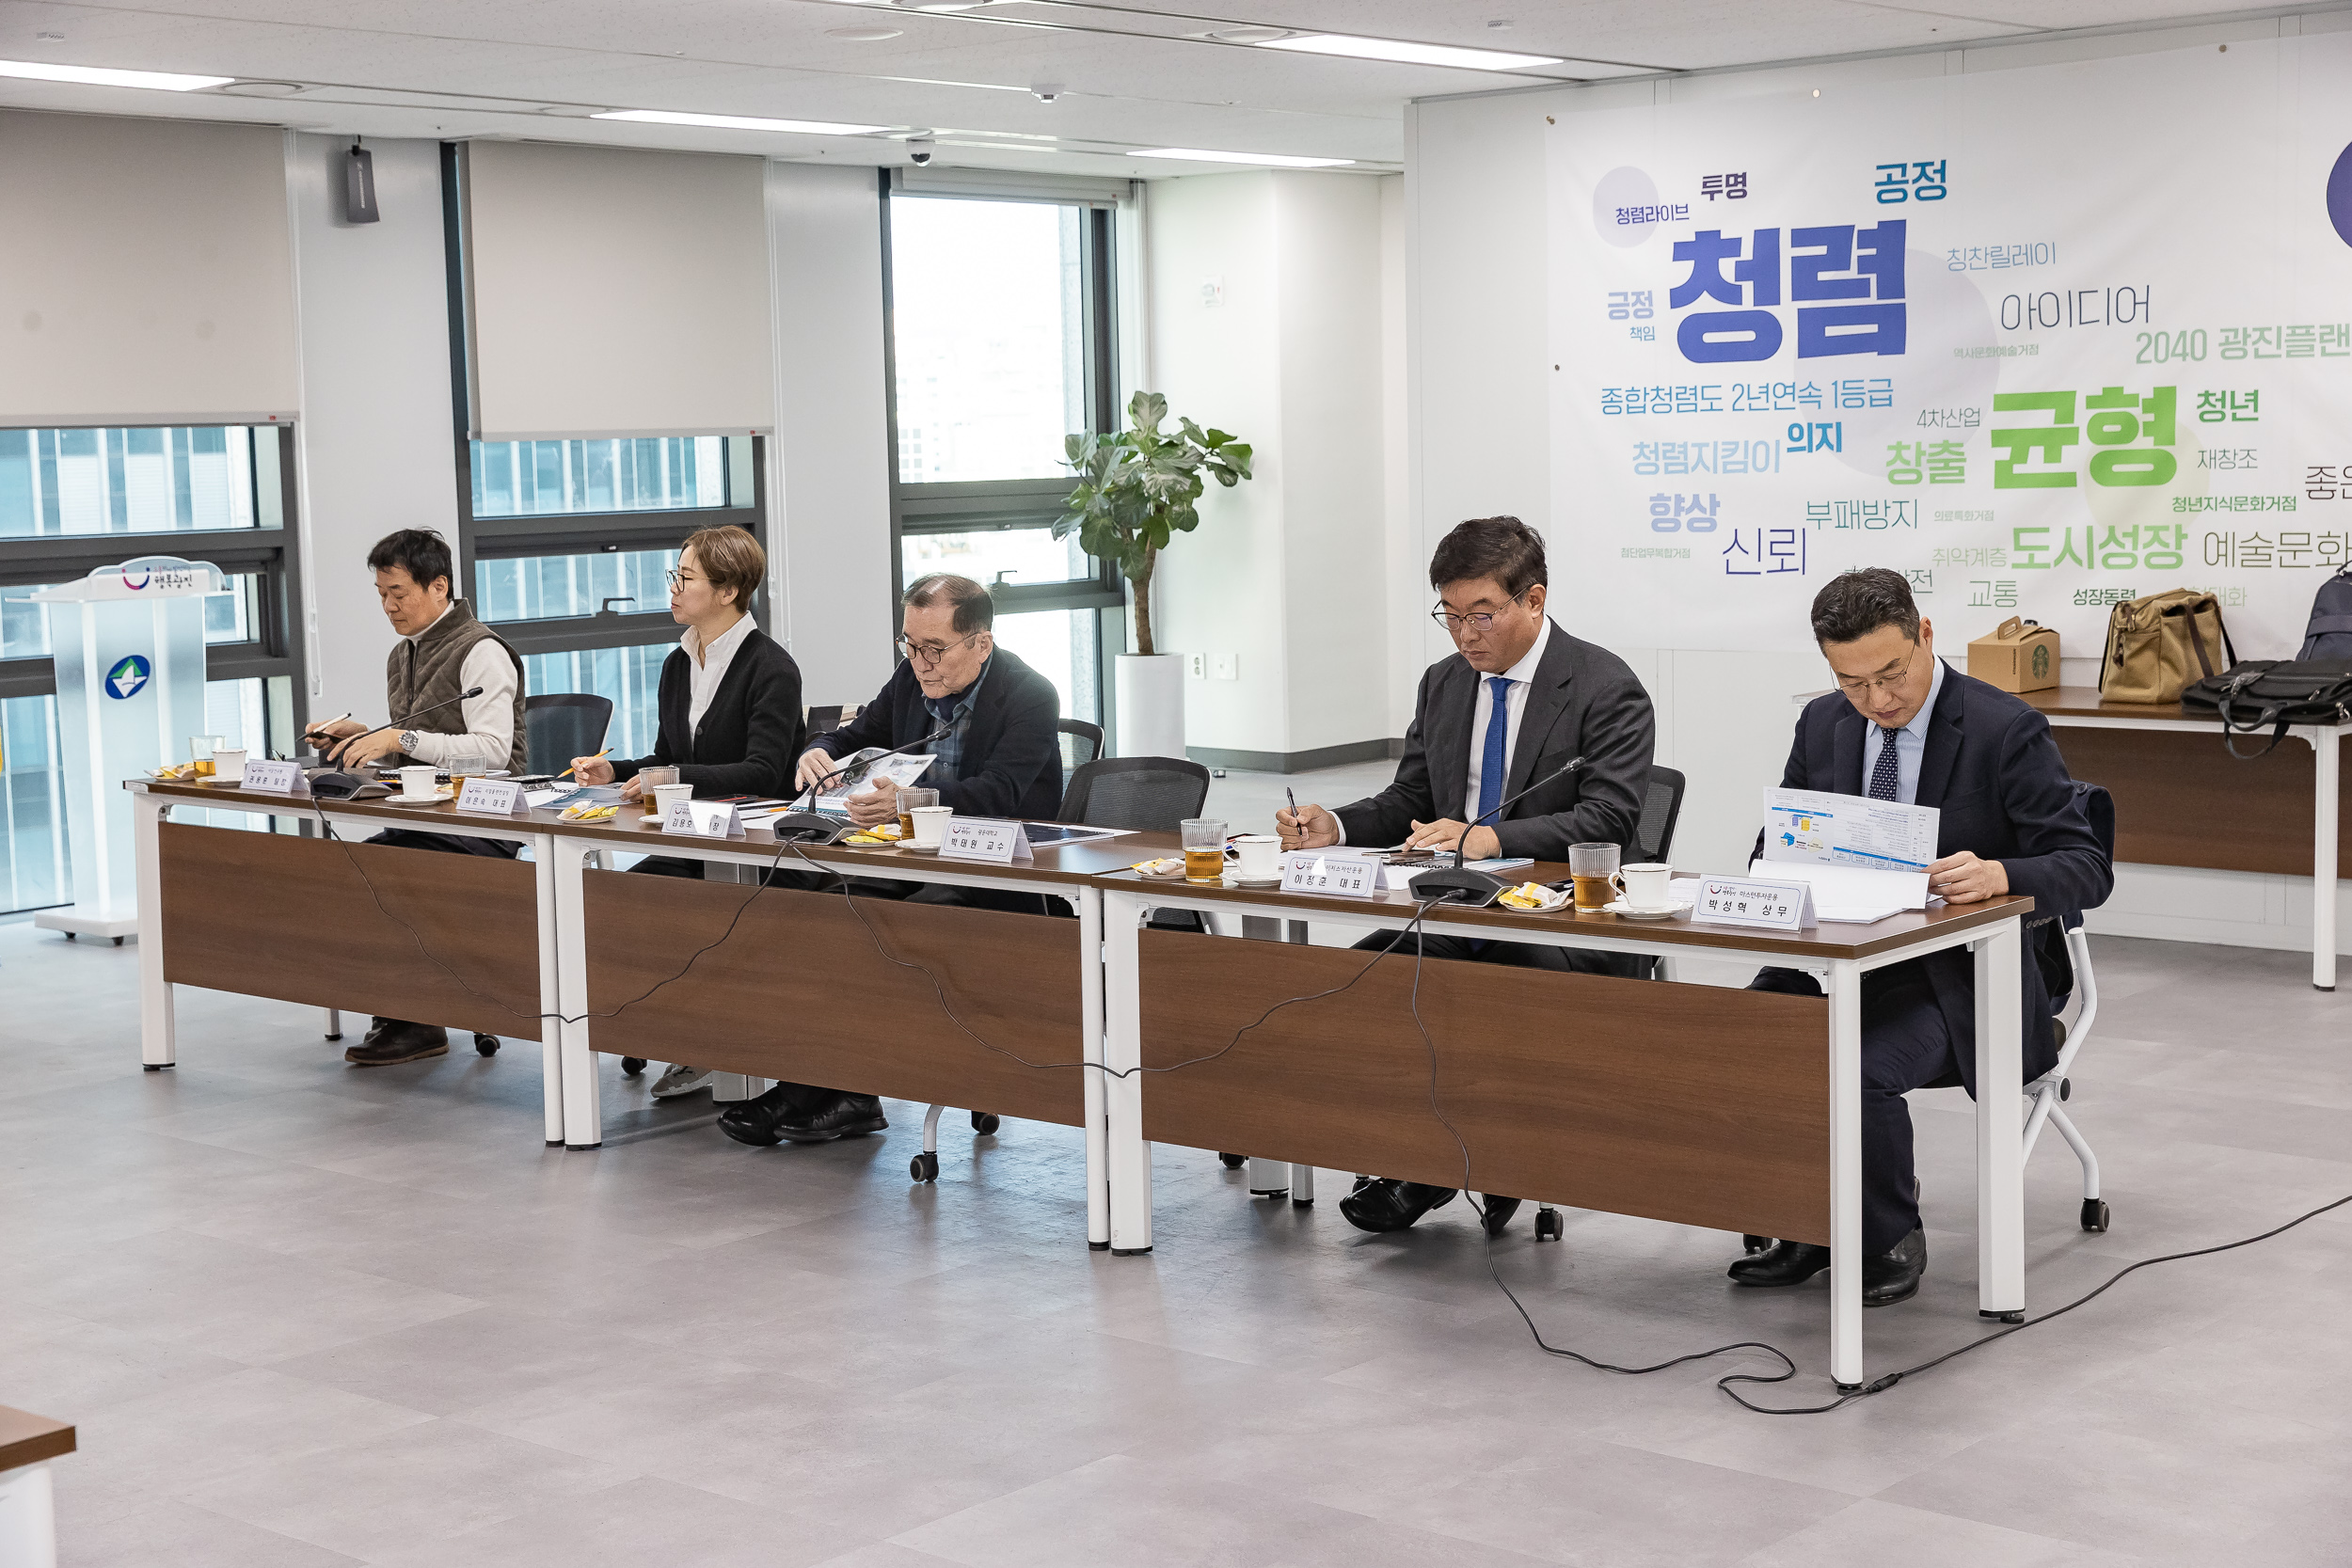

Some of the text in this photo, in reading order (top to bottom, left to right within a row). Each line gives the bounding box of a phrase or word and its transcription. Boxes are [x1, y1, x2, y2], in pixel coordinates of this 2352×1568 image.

[1701, 171, 1748, 200] 투명
[1875, 159, 1947, 204] 공정
[1615, 203, 1690, 225] 청렴라이브
[1947, 241, 2057, 272] 칭찬릴레이
[1607, 290, 1655, 320] 긍정
[1669, 219, 1907, 364] 청렴
[2001, 285, 2150, 330] 아이디어
[1629, 325, 1656, 342] 책임
[2136, 323, 2351, 365] 2040 광진플랜
[1600, 378, 1895, 416] 종합청렴도 2년연속 1등급
[2196, 388, 2260, 423] 청년
[1916, 407, 1981, 429] 4차산업
[1787, 420, 1843, 453] 의지
[1991, 385, 2178, 490] 균형
[1632, 439, 1781, 476] 청렴지킴이
[1885, 439, 1967, 485] 창출
[2197, 448, 2259, 470] 재창조
[1648, 492, 1721, 533] 향상
[1805, 499, 1918, 531] 부패방지
[2171, 496, 2297, 514] 청년지식문화거점
[1722, 527, 1806, 576] 신뢰
[1931, 547, 2008, 568] 취약계층
[2010, 524, 2189, 570] 도시성장
[2203, 531, 2352, 568] 예술문화
[1966, 579, 2019, 609] 교통
[2073, 588, 2137, 607] 성장동력
[2187, 586, 2248, 608] 대화
[951, 838, 1004, 851] 박태원 교수
[1340, 878, 1361, 890] 대표
[1708, 899, 1788, 917] 박성혁 상무
